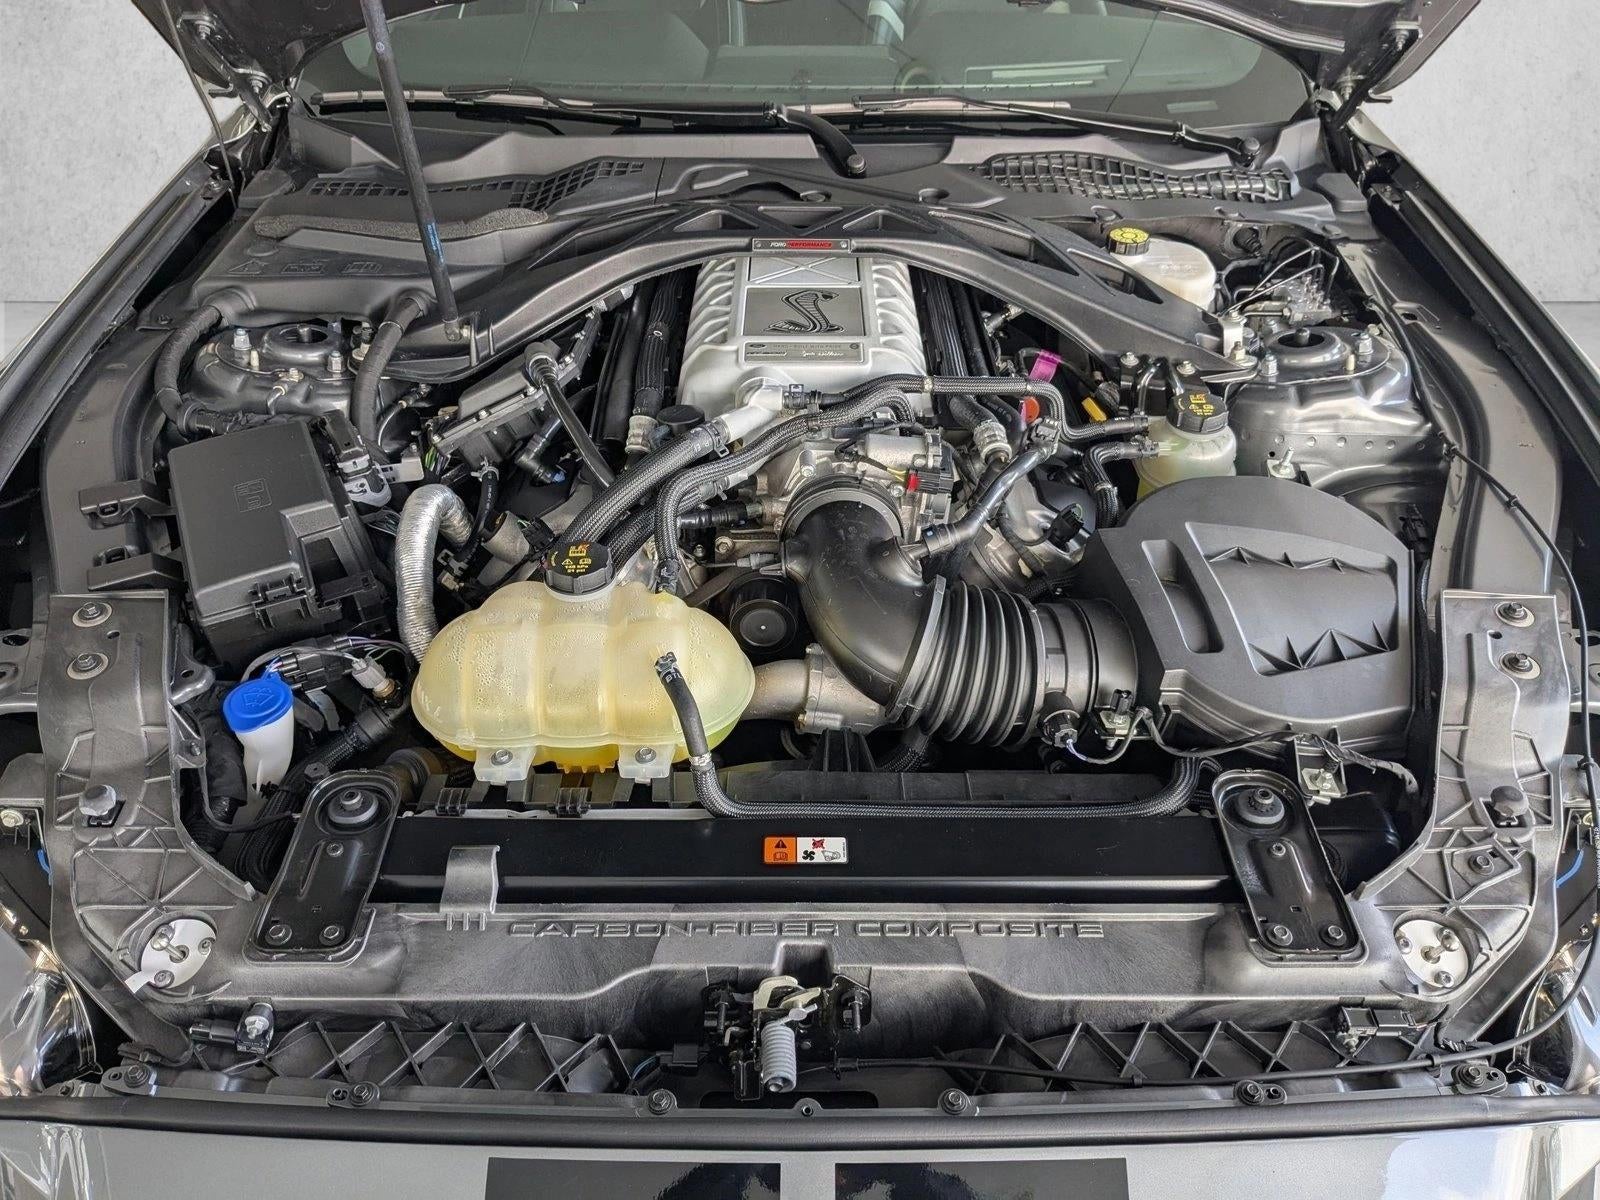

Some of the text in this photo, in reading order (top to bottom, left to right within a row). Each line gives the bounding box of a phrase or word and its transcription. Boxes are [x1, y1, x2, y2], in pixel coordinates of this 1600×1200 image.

[787, 240, 833, 248] PERFORMANCE
[509, 921, 1104, 938] CARBON-FIBER COMPOSITE
